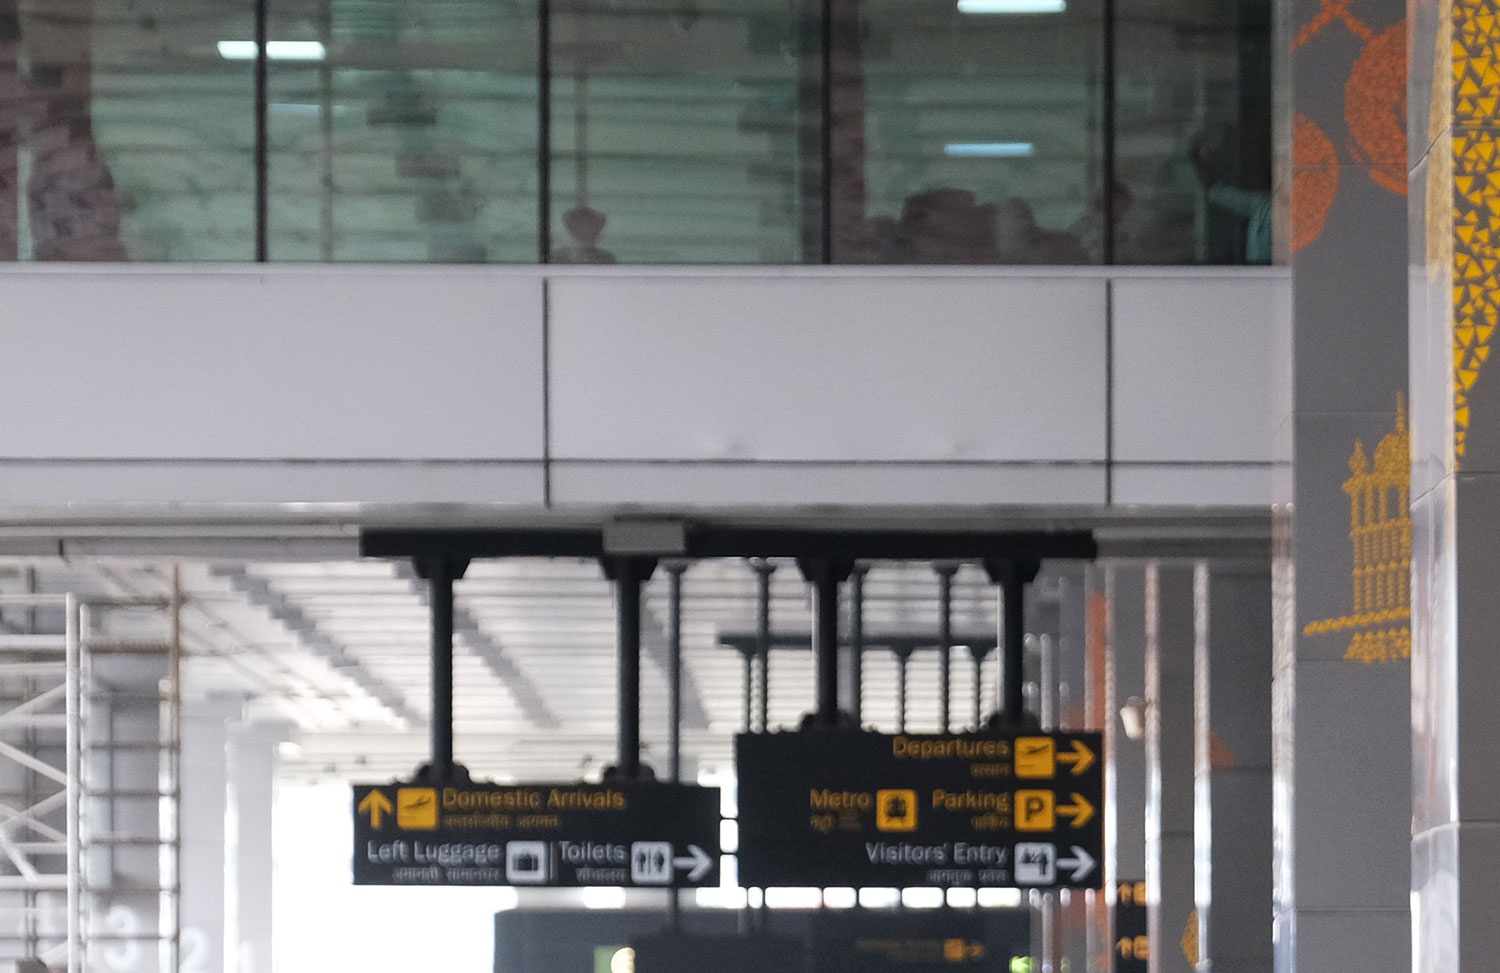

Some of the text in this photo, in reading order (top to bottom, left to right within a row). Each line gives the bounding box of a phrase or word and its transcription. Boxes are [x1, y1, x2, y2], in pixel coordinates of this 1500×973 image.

[892, 738, 1009, 759] Departures
[442, 788, 626, 810] Domestic Arrivals
[809, 788, 872, 810] Metro
[931, 789, 1010, 815] Parking
[367, 840, 501, 867] Left Luggage
[558, 840, 626, 862] Toilets
[953, 842, 1008, 867] Entry
